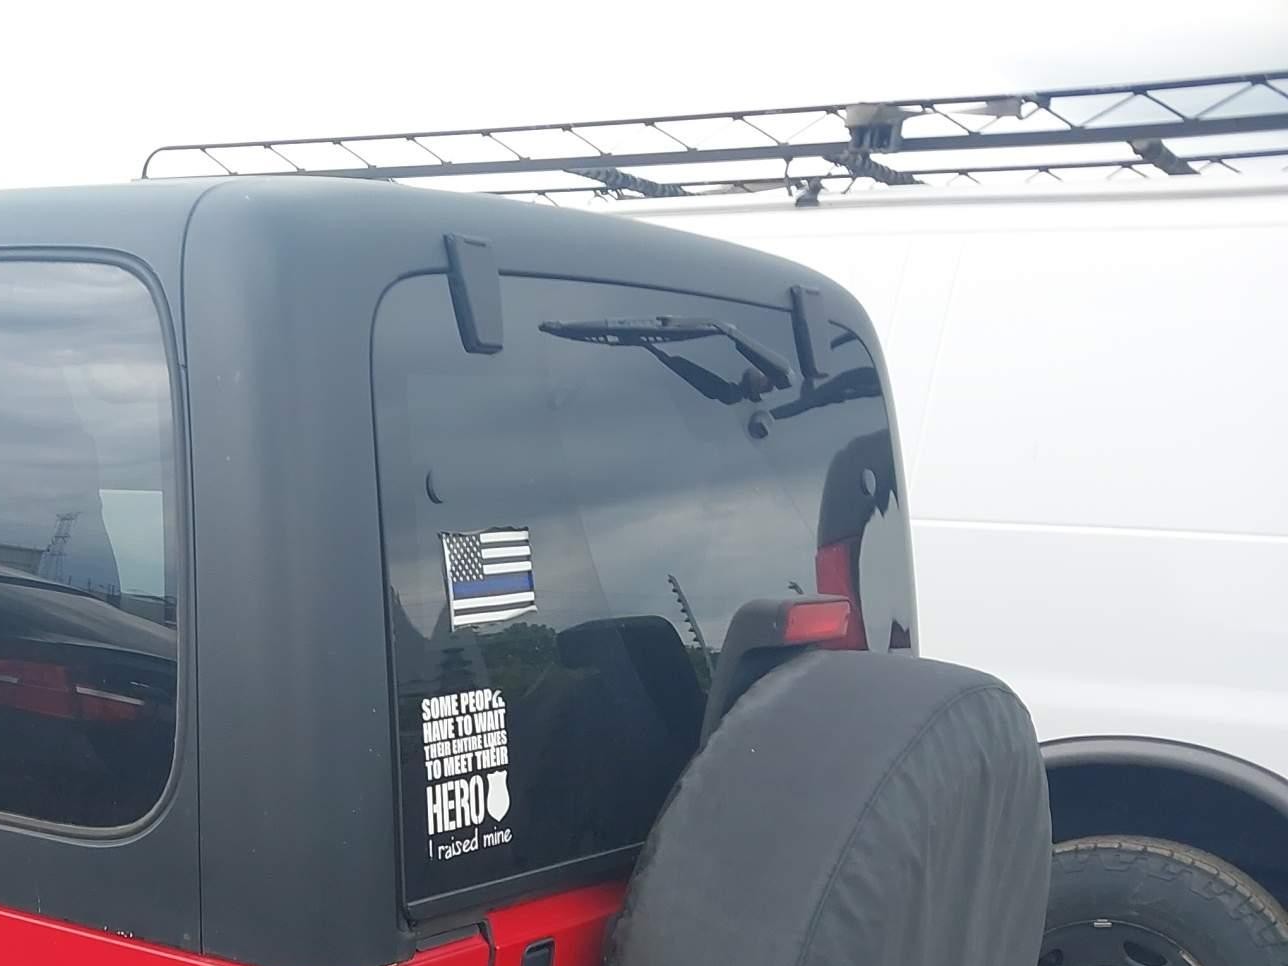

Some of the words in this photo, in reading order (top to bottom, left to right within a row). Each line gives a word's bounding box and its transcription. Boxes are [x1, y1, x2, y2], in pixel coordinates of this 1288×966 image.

[421, 693, 459, 721] SOME
[422, 717, 455, 744] HAVE
[455, 714, 473, 737] TO
[473, 708, 506, 733] WAIT
[424, 740, 452, 761] THEIR
[452, 734, 483, 754] ENTIRE
[483, 729, 508, 749] LIVES
[425, 759, 442, 780] TO
[443, 752, 474, 777] MEET
[474, 745, 509, 770] THEIR
[426, 774, 485, 835] HERO
[429, 839, 433, 858] I
[438, 827, 479, 860] raised
[483, 826, 513, 848] mine
